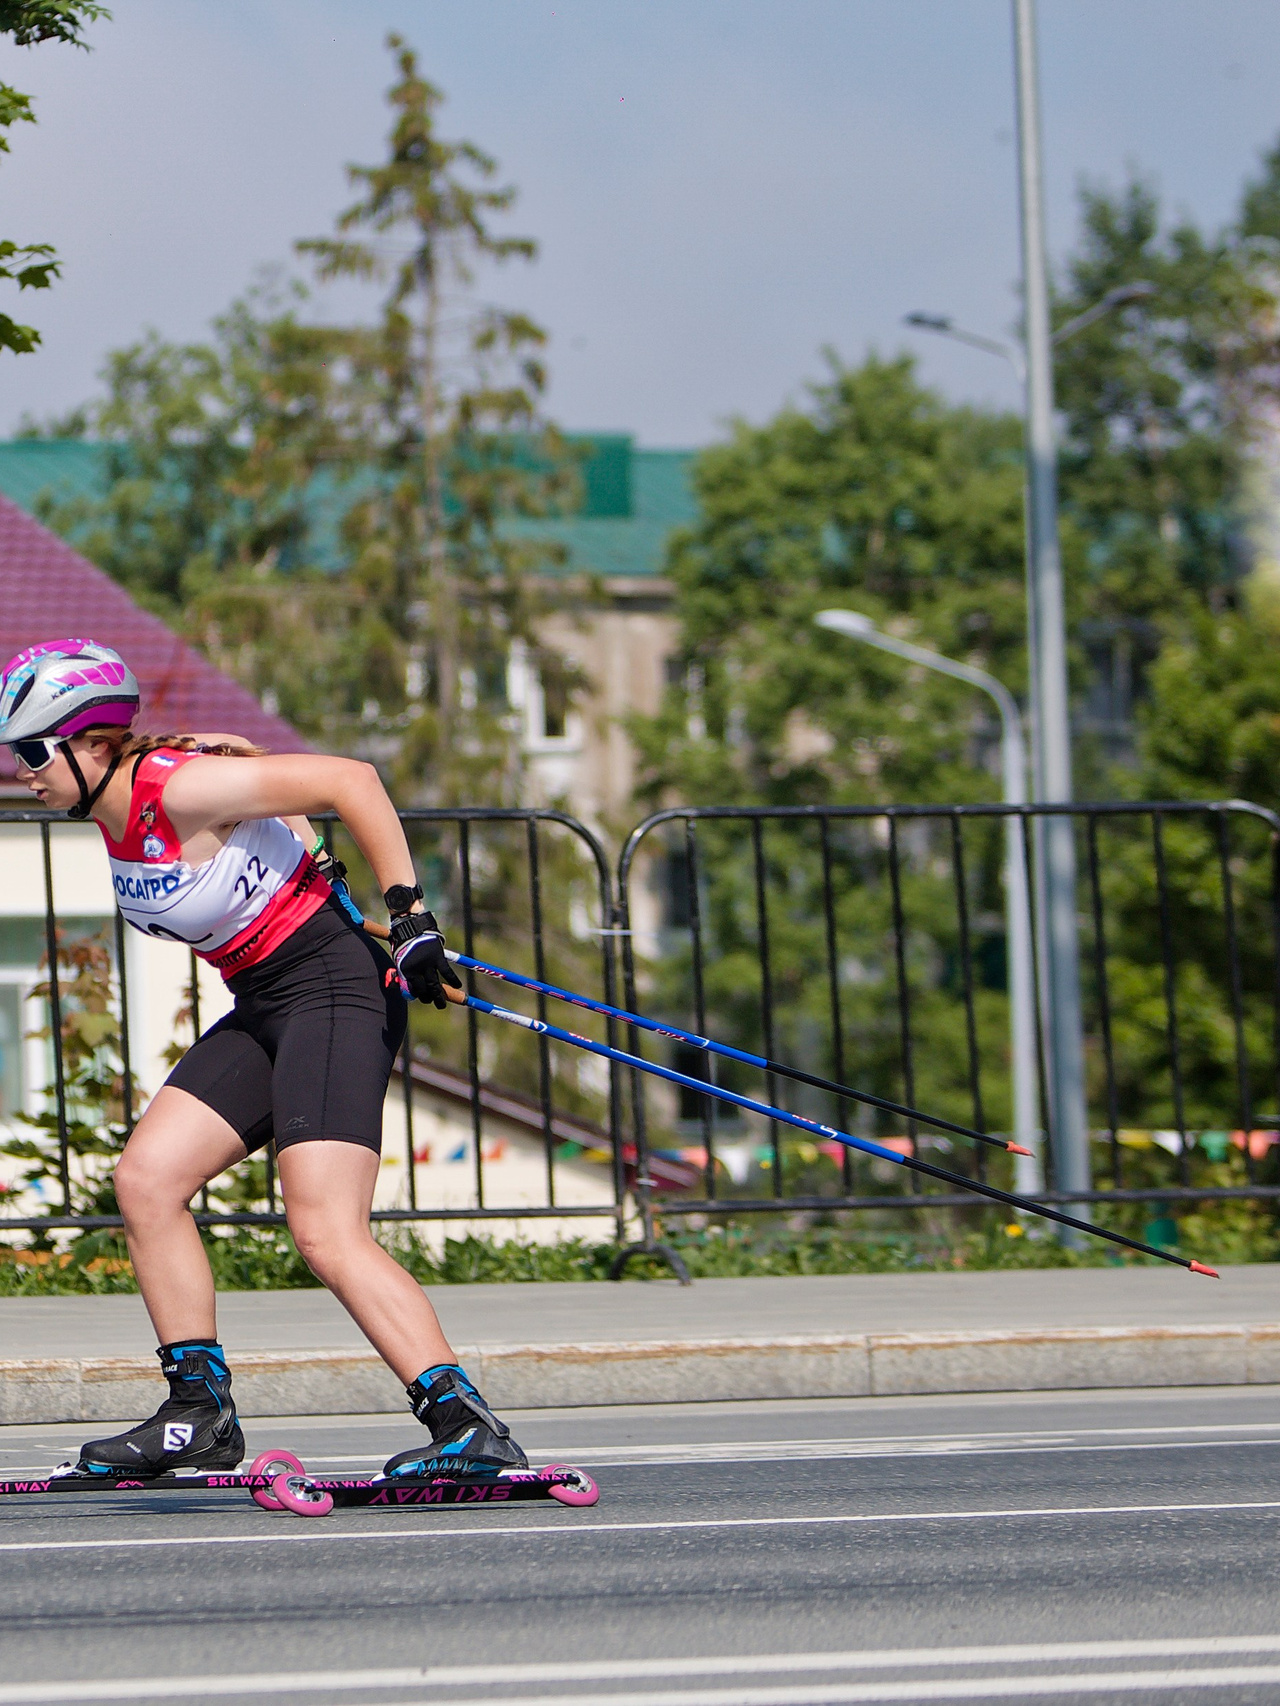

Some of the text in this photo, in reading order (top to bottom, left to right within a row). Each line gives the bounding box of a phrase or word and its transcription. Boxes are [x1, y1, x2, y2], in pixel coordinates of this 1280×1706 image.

[234, 855, 269, 900] 22
[112, 874, 180, 900] ОСАГРО
[207, 1476, 275, 1487] SKI WAY
[509, 1473, 568, 1482] SKI WAY
[15, 1481, 52, 1492] WAY
[313, 1480, 373, 1489] SKI WAY
[369, 1484, 514, 1504] SKI WAY
